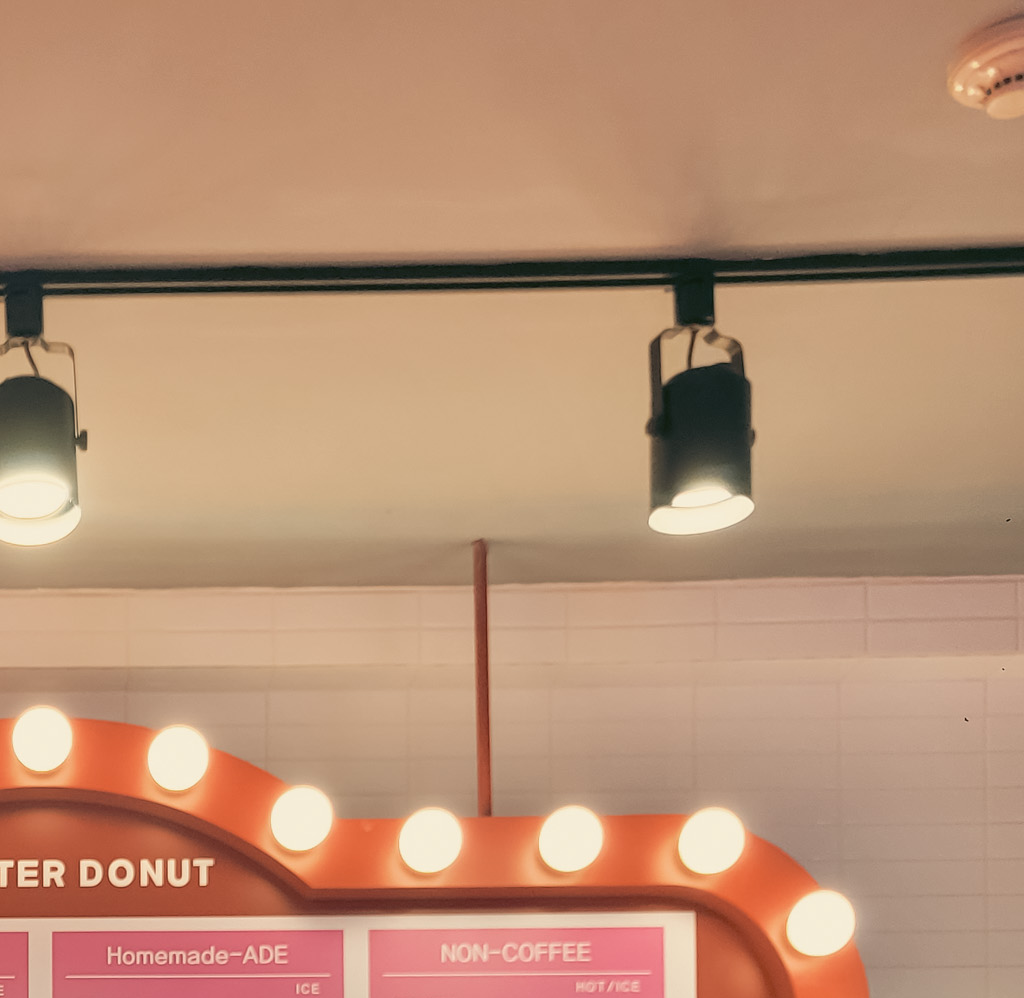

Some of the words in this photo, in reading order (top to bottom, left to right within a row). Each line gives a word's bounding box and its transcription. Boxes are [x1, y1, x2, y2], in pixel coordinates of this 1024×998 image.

[78, 857, 215, 888] DONUT
[108, 944, 288, 964] Homemade-ADE
[441, 942, 591, 962] NON-COFFEE
[296, 983, 319, 994] ICE
[576, 980, 640, 992] HOT/ICE
